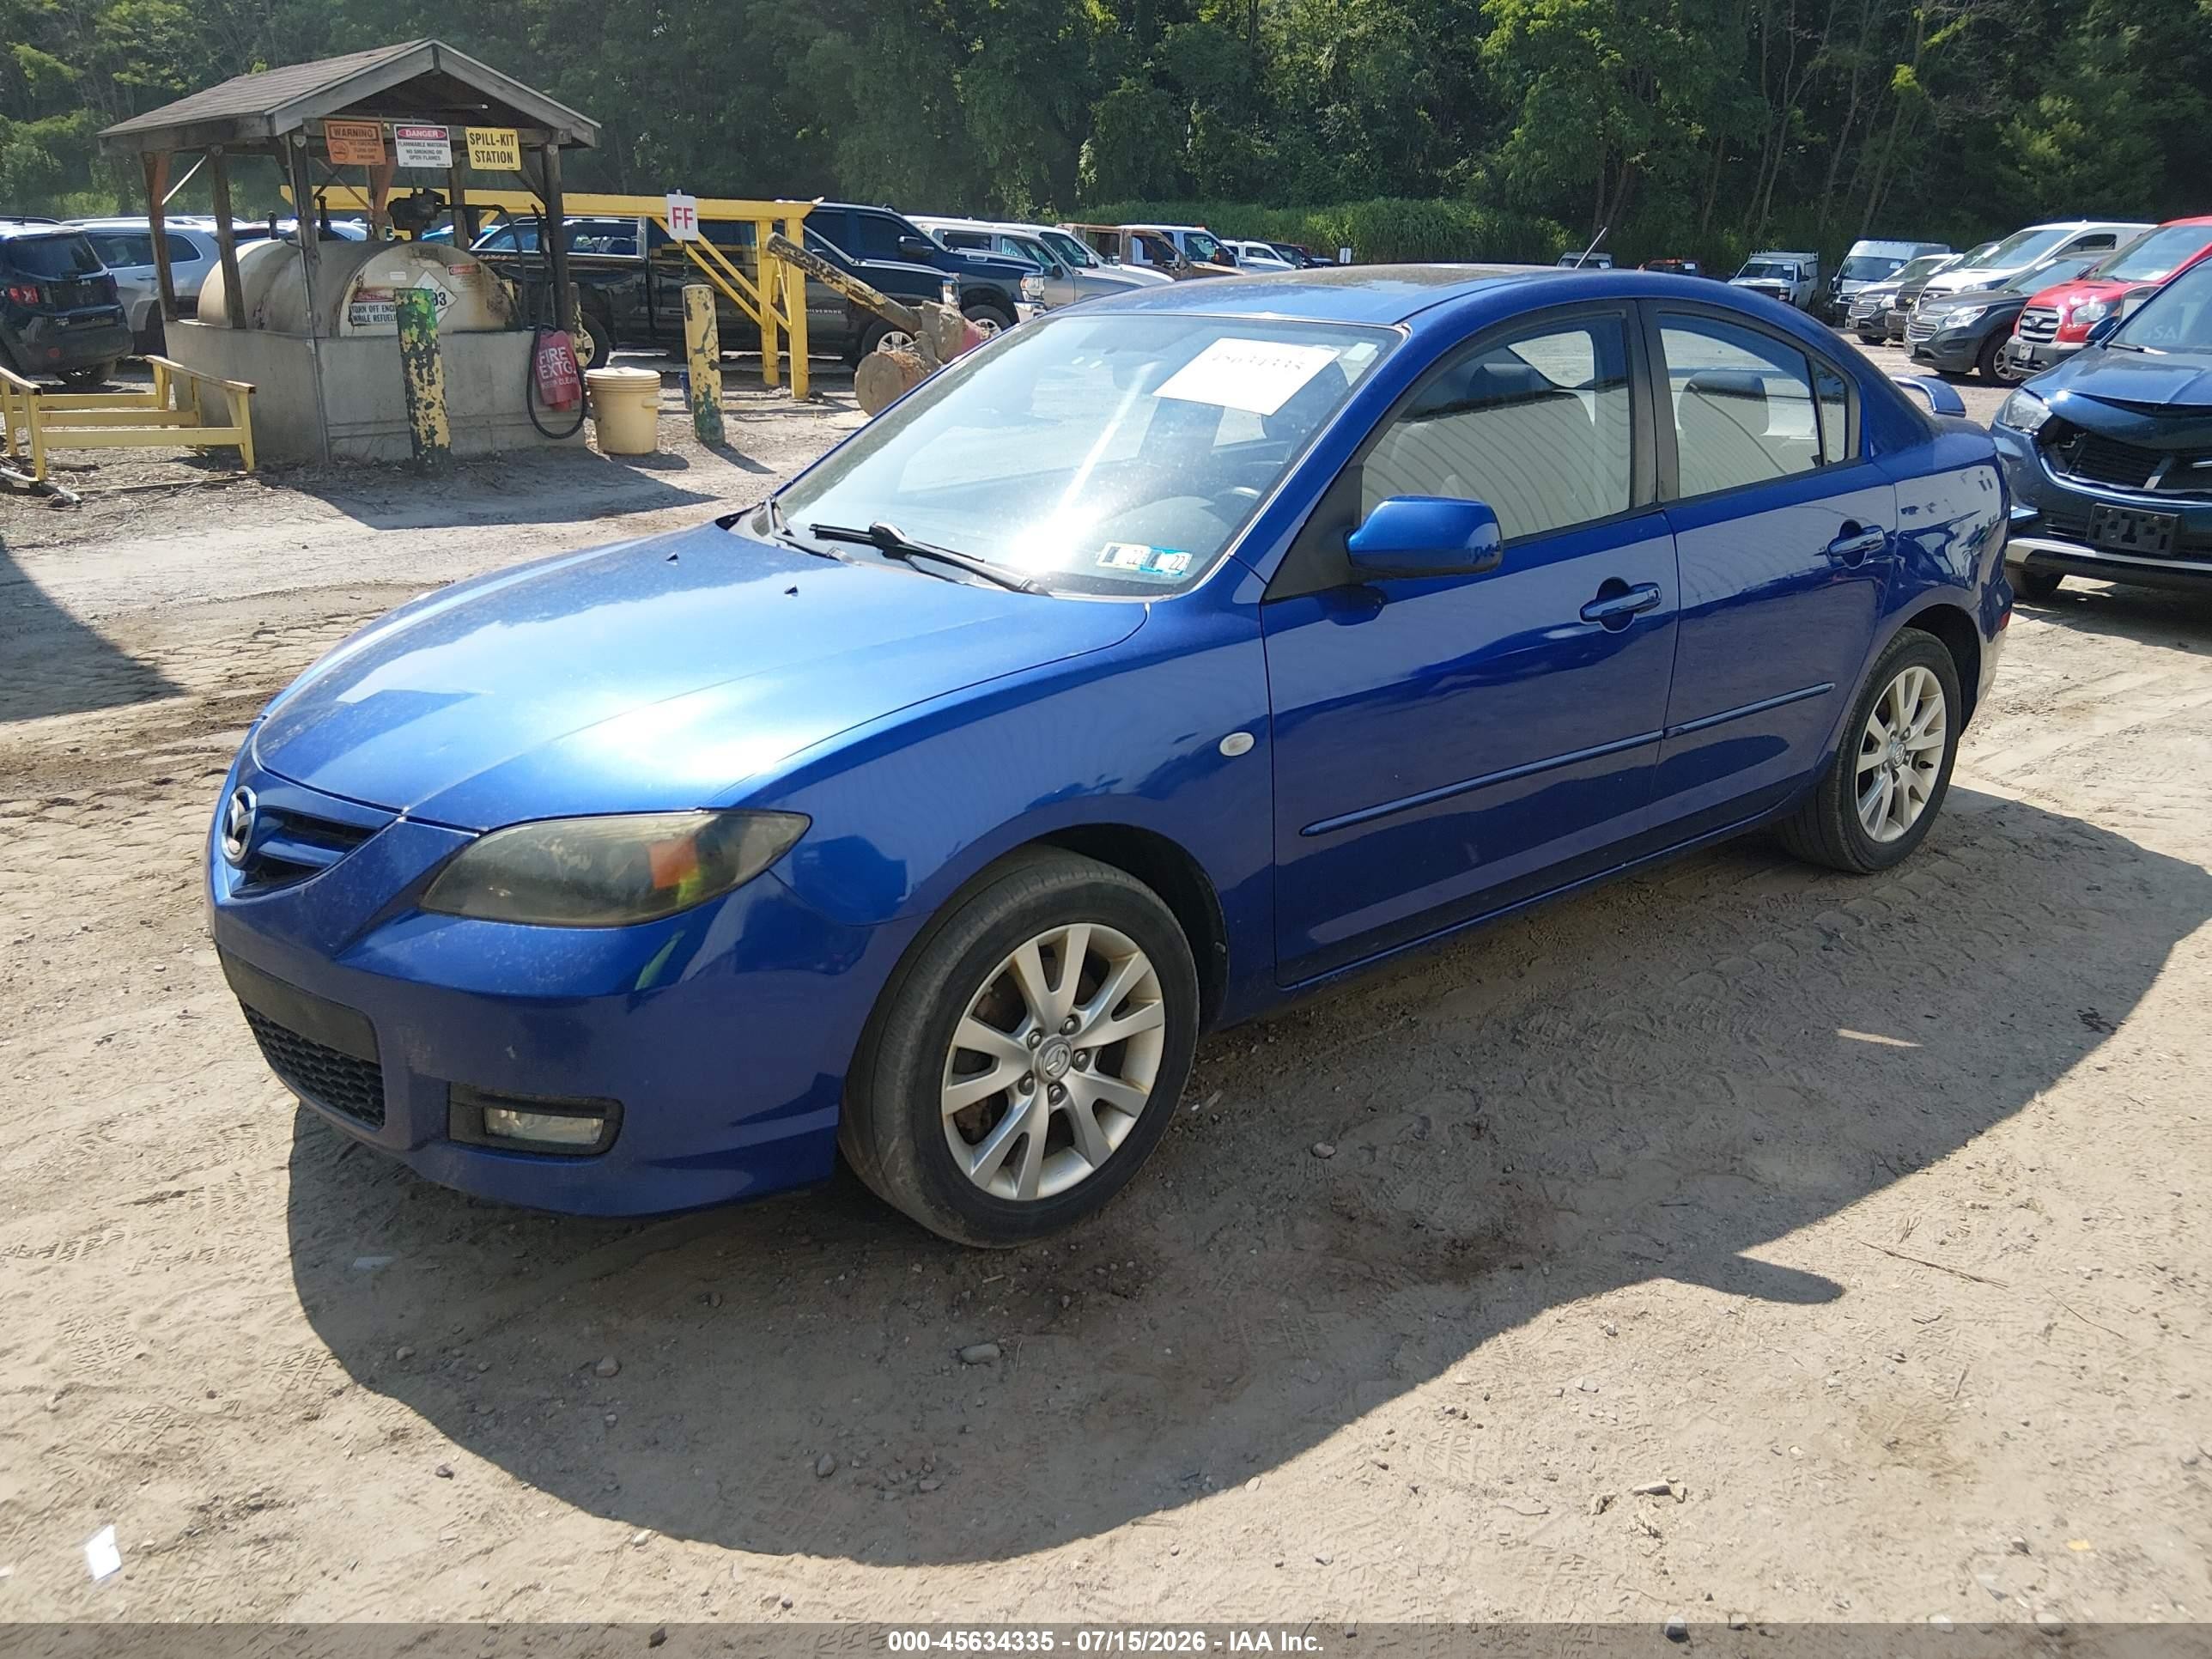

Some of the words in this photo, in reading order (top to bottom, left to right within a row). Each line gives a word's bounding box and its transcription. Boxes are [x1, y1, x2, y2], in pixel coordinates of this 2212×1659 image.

[333, 128, 373, 137] WARNING
[469, 132, 514, 146] SPILL-KIT
[475, 150, 514, 164] STATION
[672, 206, 694, 230] FF
[352, 305, 367, 313] TURN
[368, 304, 379, 313] OFF
[538, 346, 568, 365] FIRE
[539, 361, 577, 380] EXTG.
